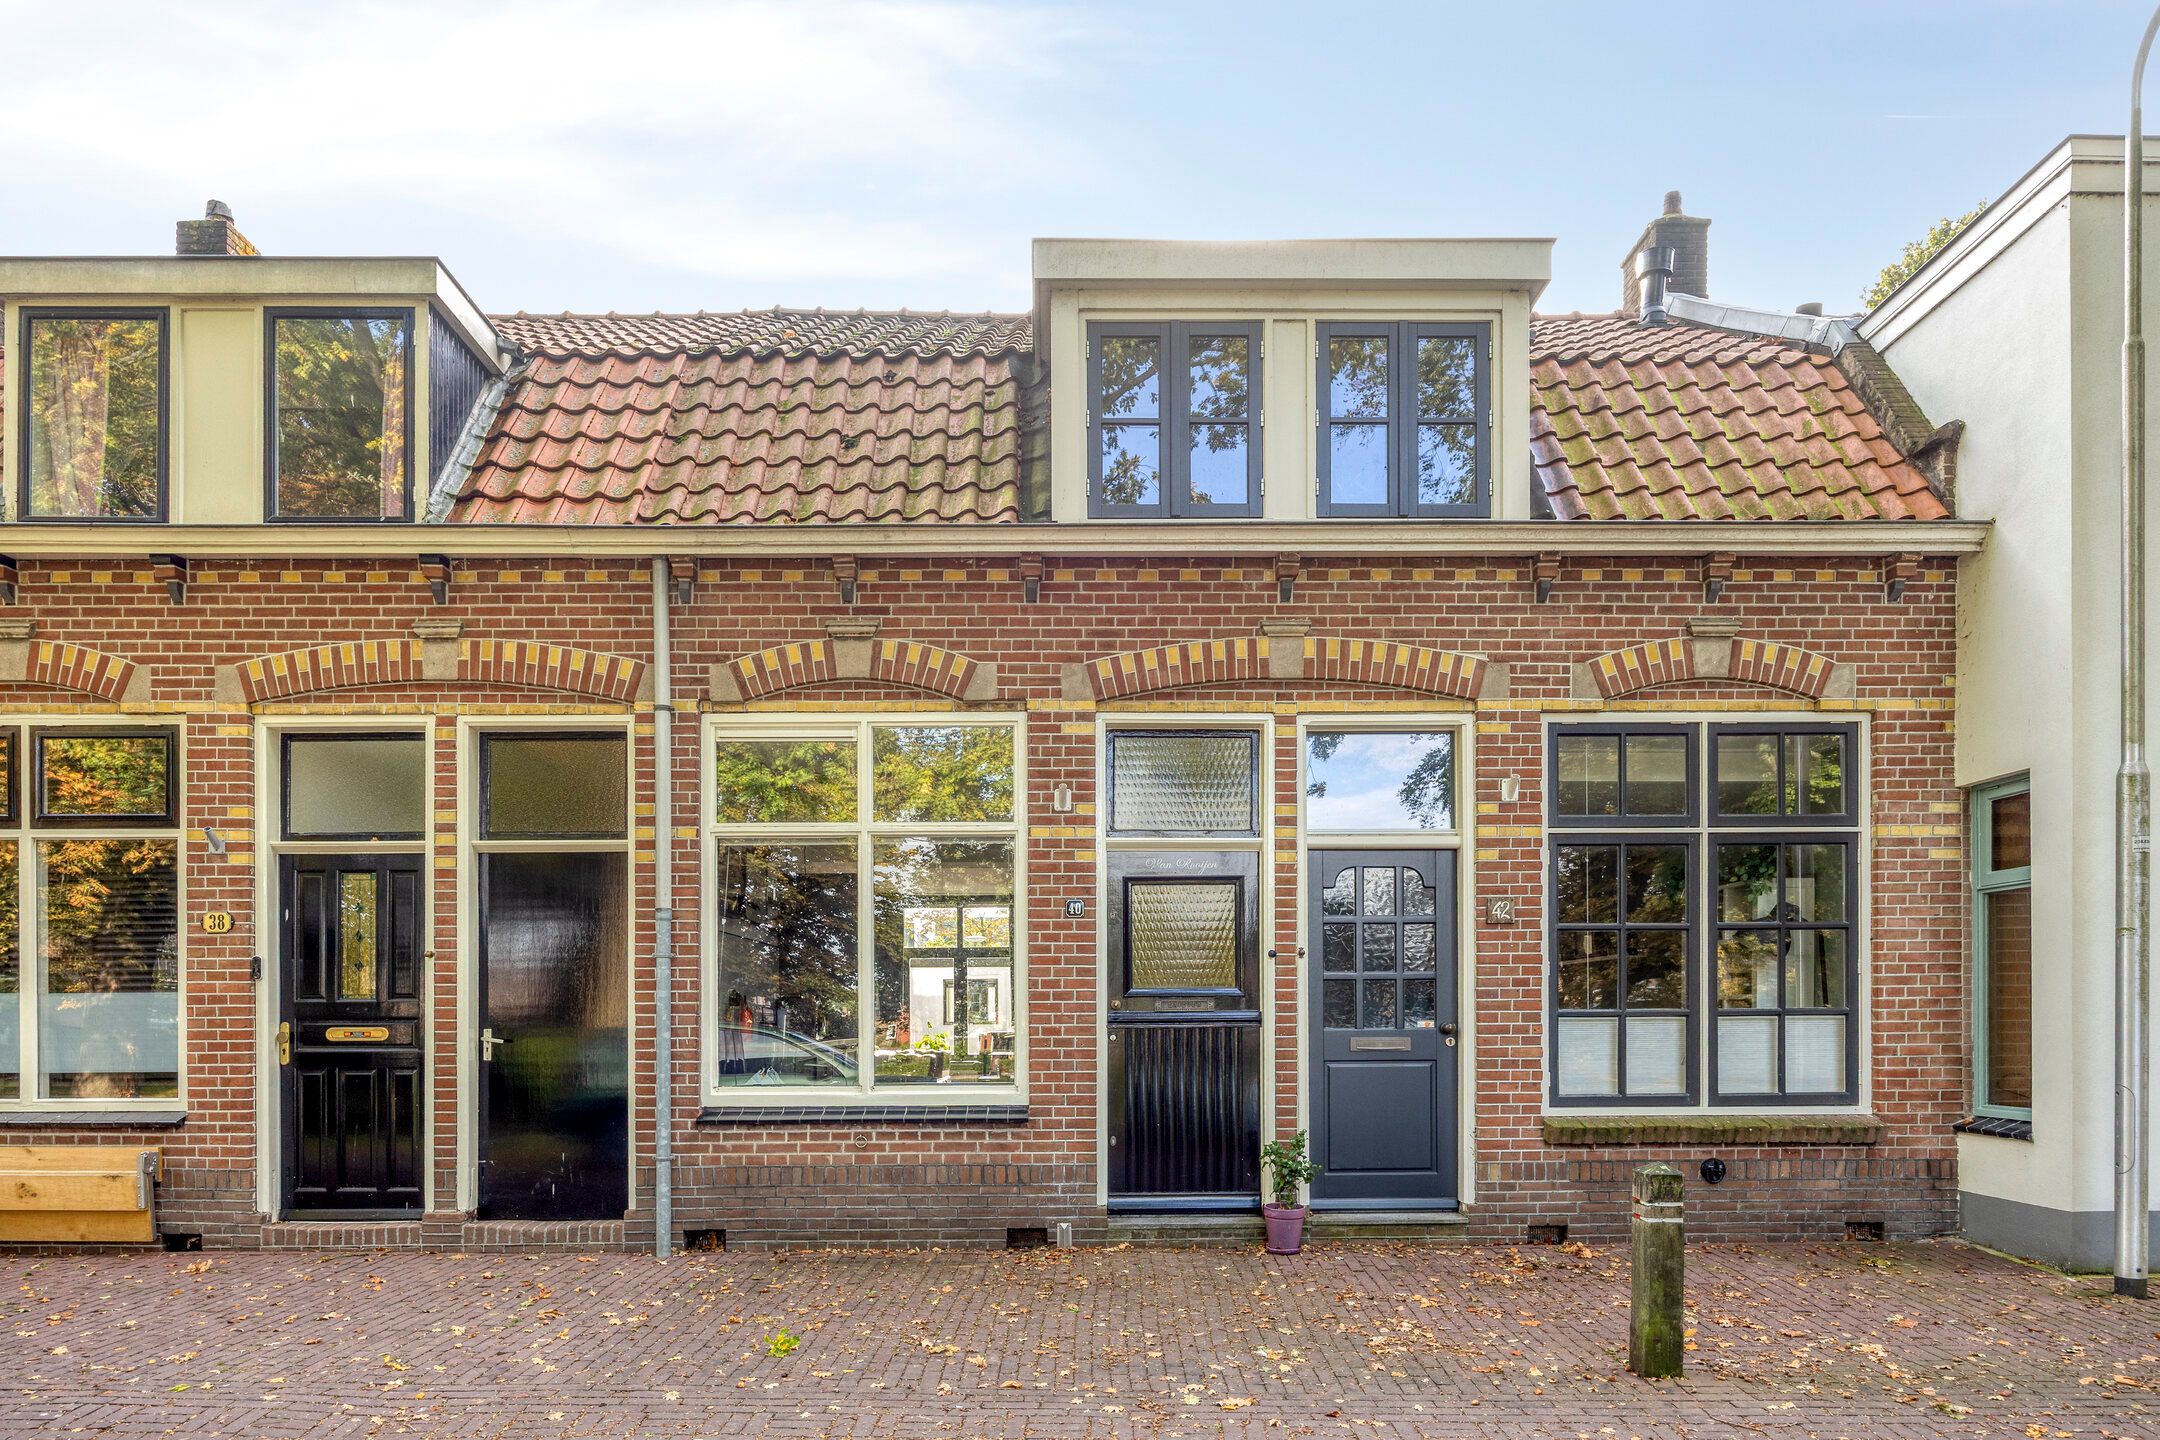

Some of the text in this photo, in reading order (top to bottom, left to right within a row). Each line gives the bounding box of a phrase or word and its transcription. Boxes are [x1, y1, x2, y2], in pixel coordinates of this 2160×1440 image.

[1145, 857, 1172, 869] Van
[1069, 902, 1081, 914] 40
[1491, 901, 1510, 919] 42
[209, 914, 225, 930] 38
